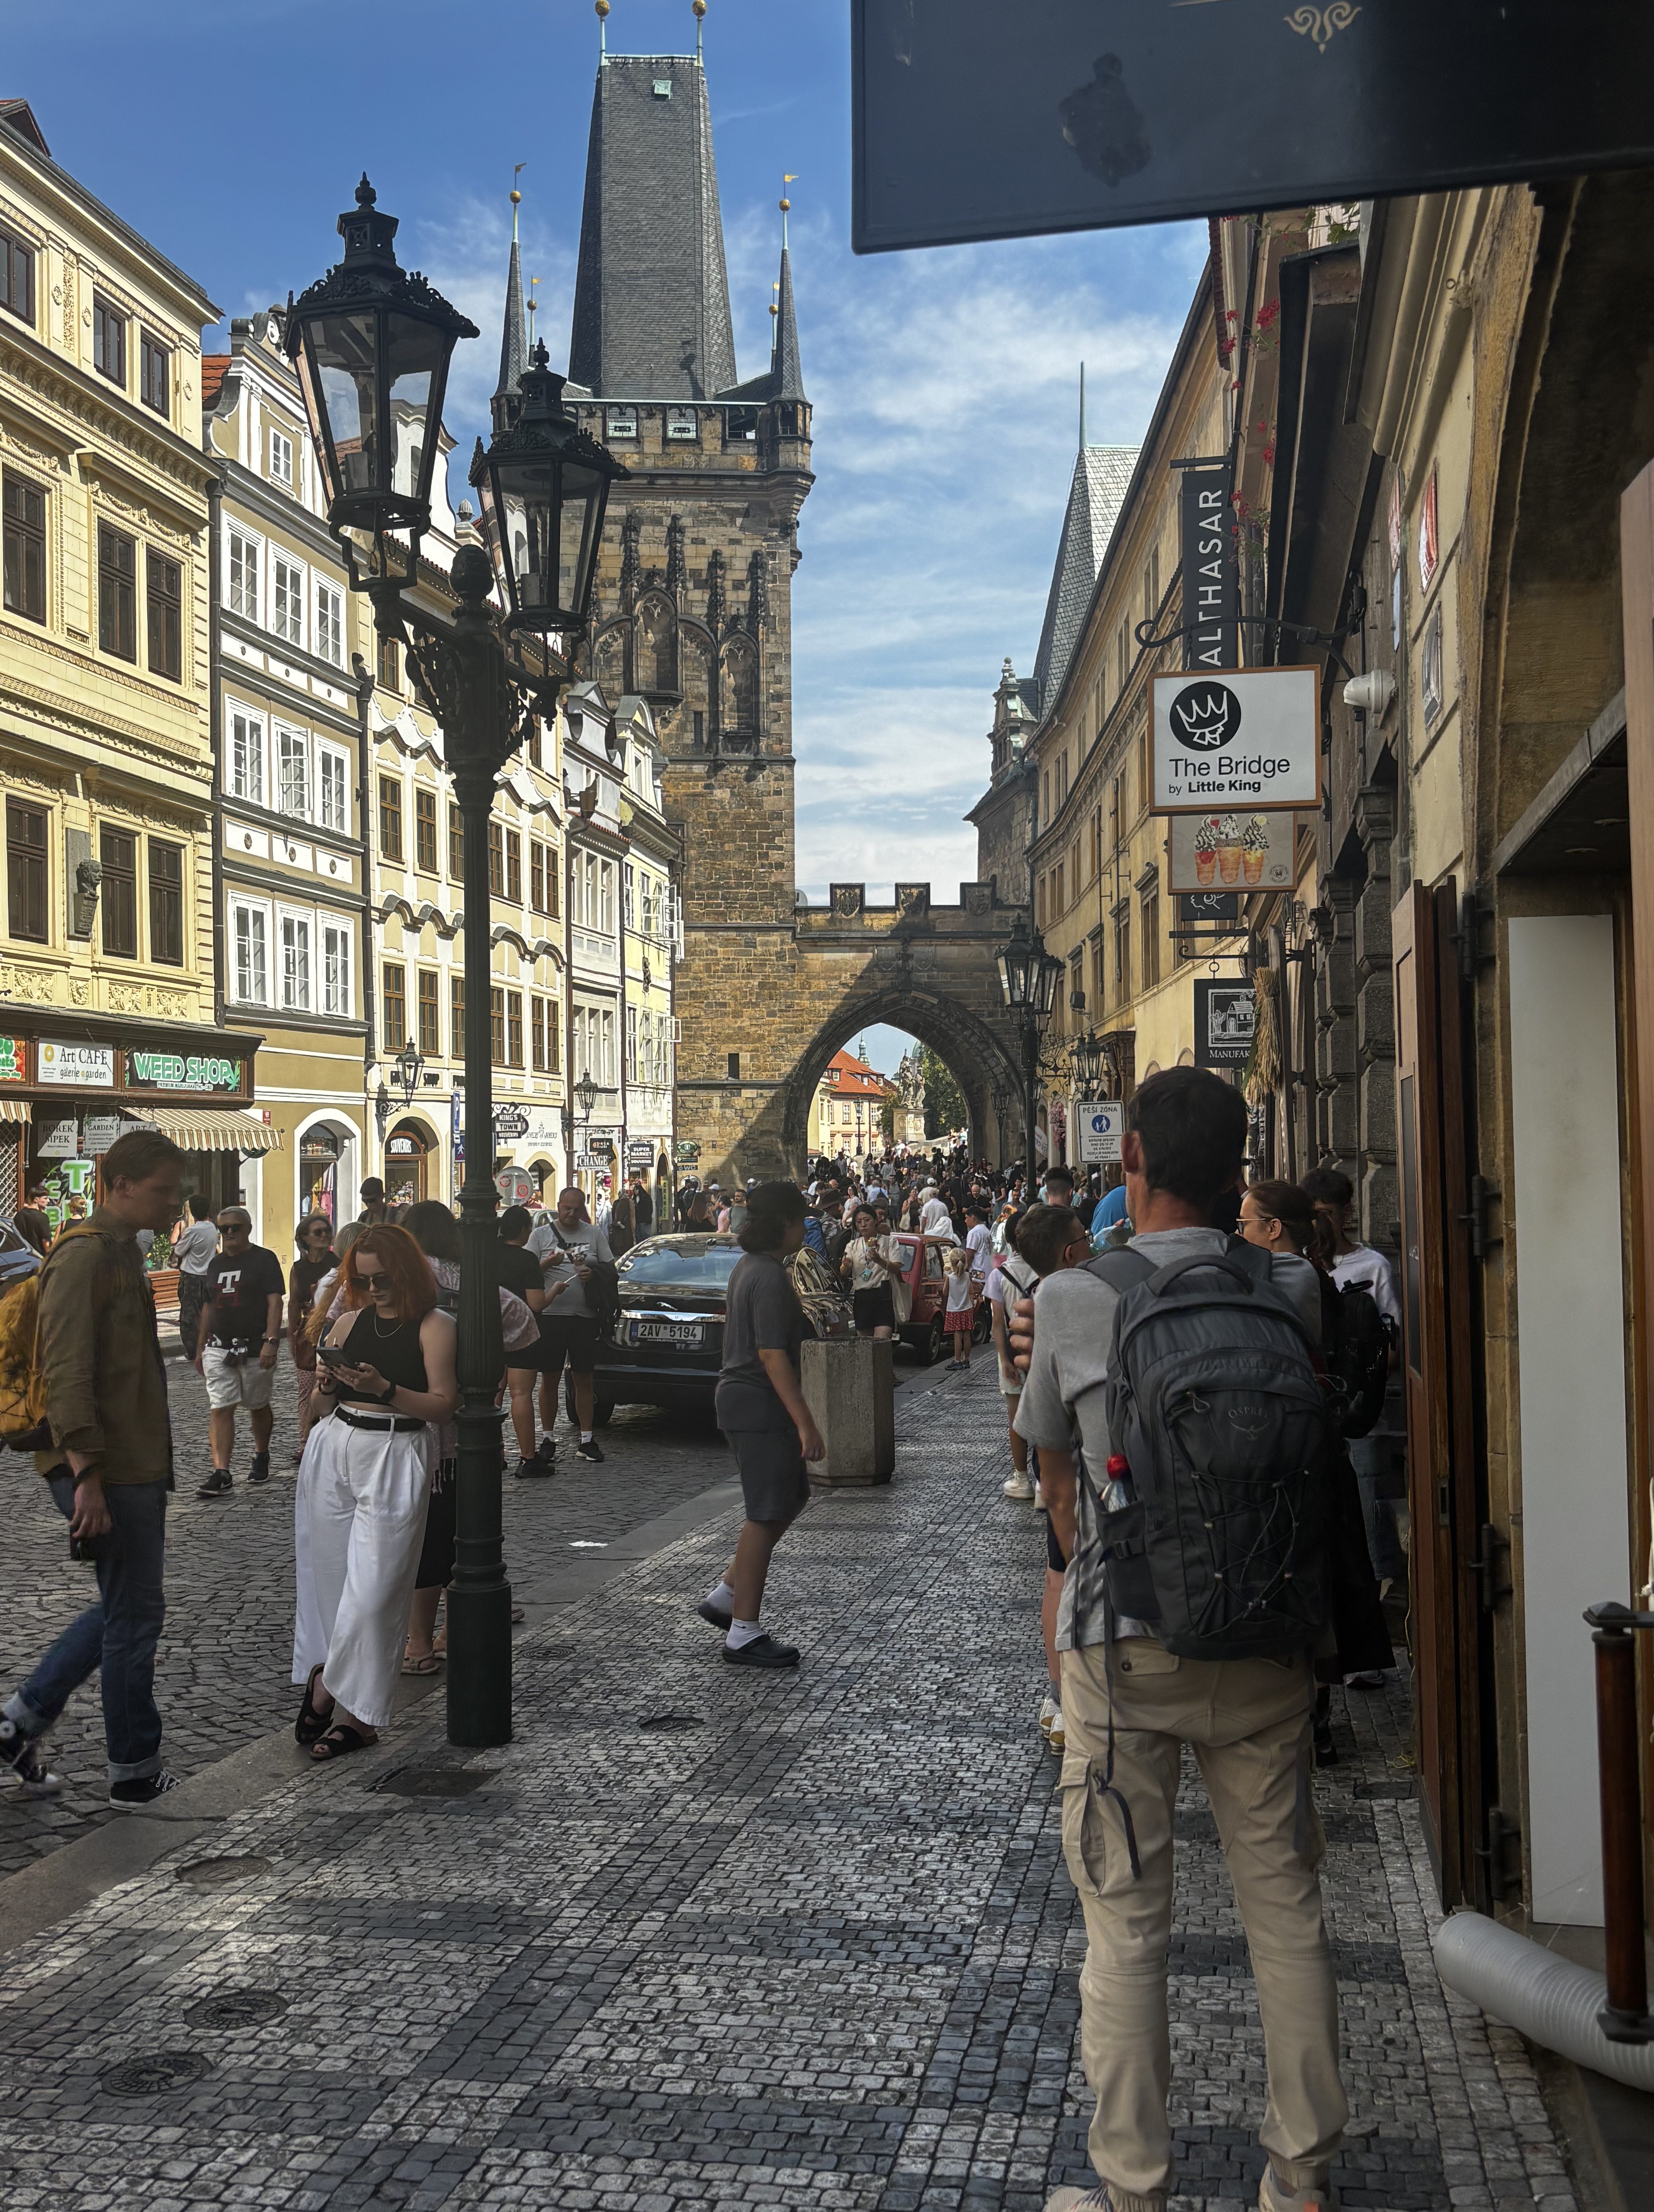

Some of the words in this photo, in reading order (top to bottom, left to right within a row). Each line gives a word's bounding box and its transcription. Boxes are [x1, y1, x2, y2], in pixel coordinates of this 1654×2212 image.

[1198, 489, 1222, 666] ALTHASAR
[1169, 758, 1210, 777] The
[1218, 755, 1290, 779] Bridge
[1168, 784, 1182, 795] by
[1188, 780, 1225, 793] Little
[1228, 780, 1261, 793] King
[60, 1048, 75, 1063] Art
[1209, 1050, 1250, 1058] MANUFAK
[60, 1068, 80, 1079] galerie
[86, 1069, 106, 1080] garden
[134, 1052, 185, 1082] WEED
[186, 1056, 232, 1084] SHOP
[579, 1155, 608, 1166] CHANGE
[640, 1325, 661, 1337] 2AV
[669, 1326, 697, 1339] 5194
